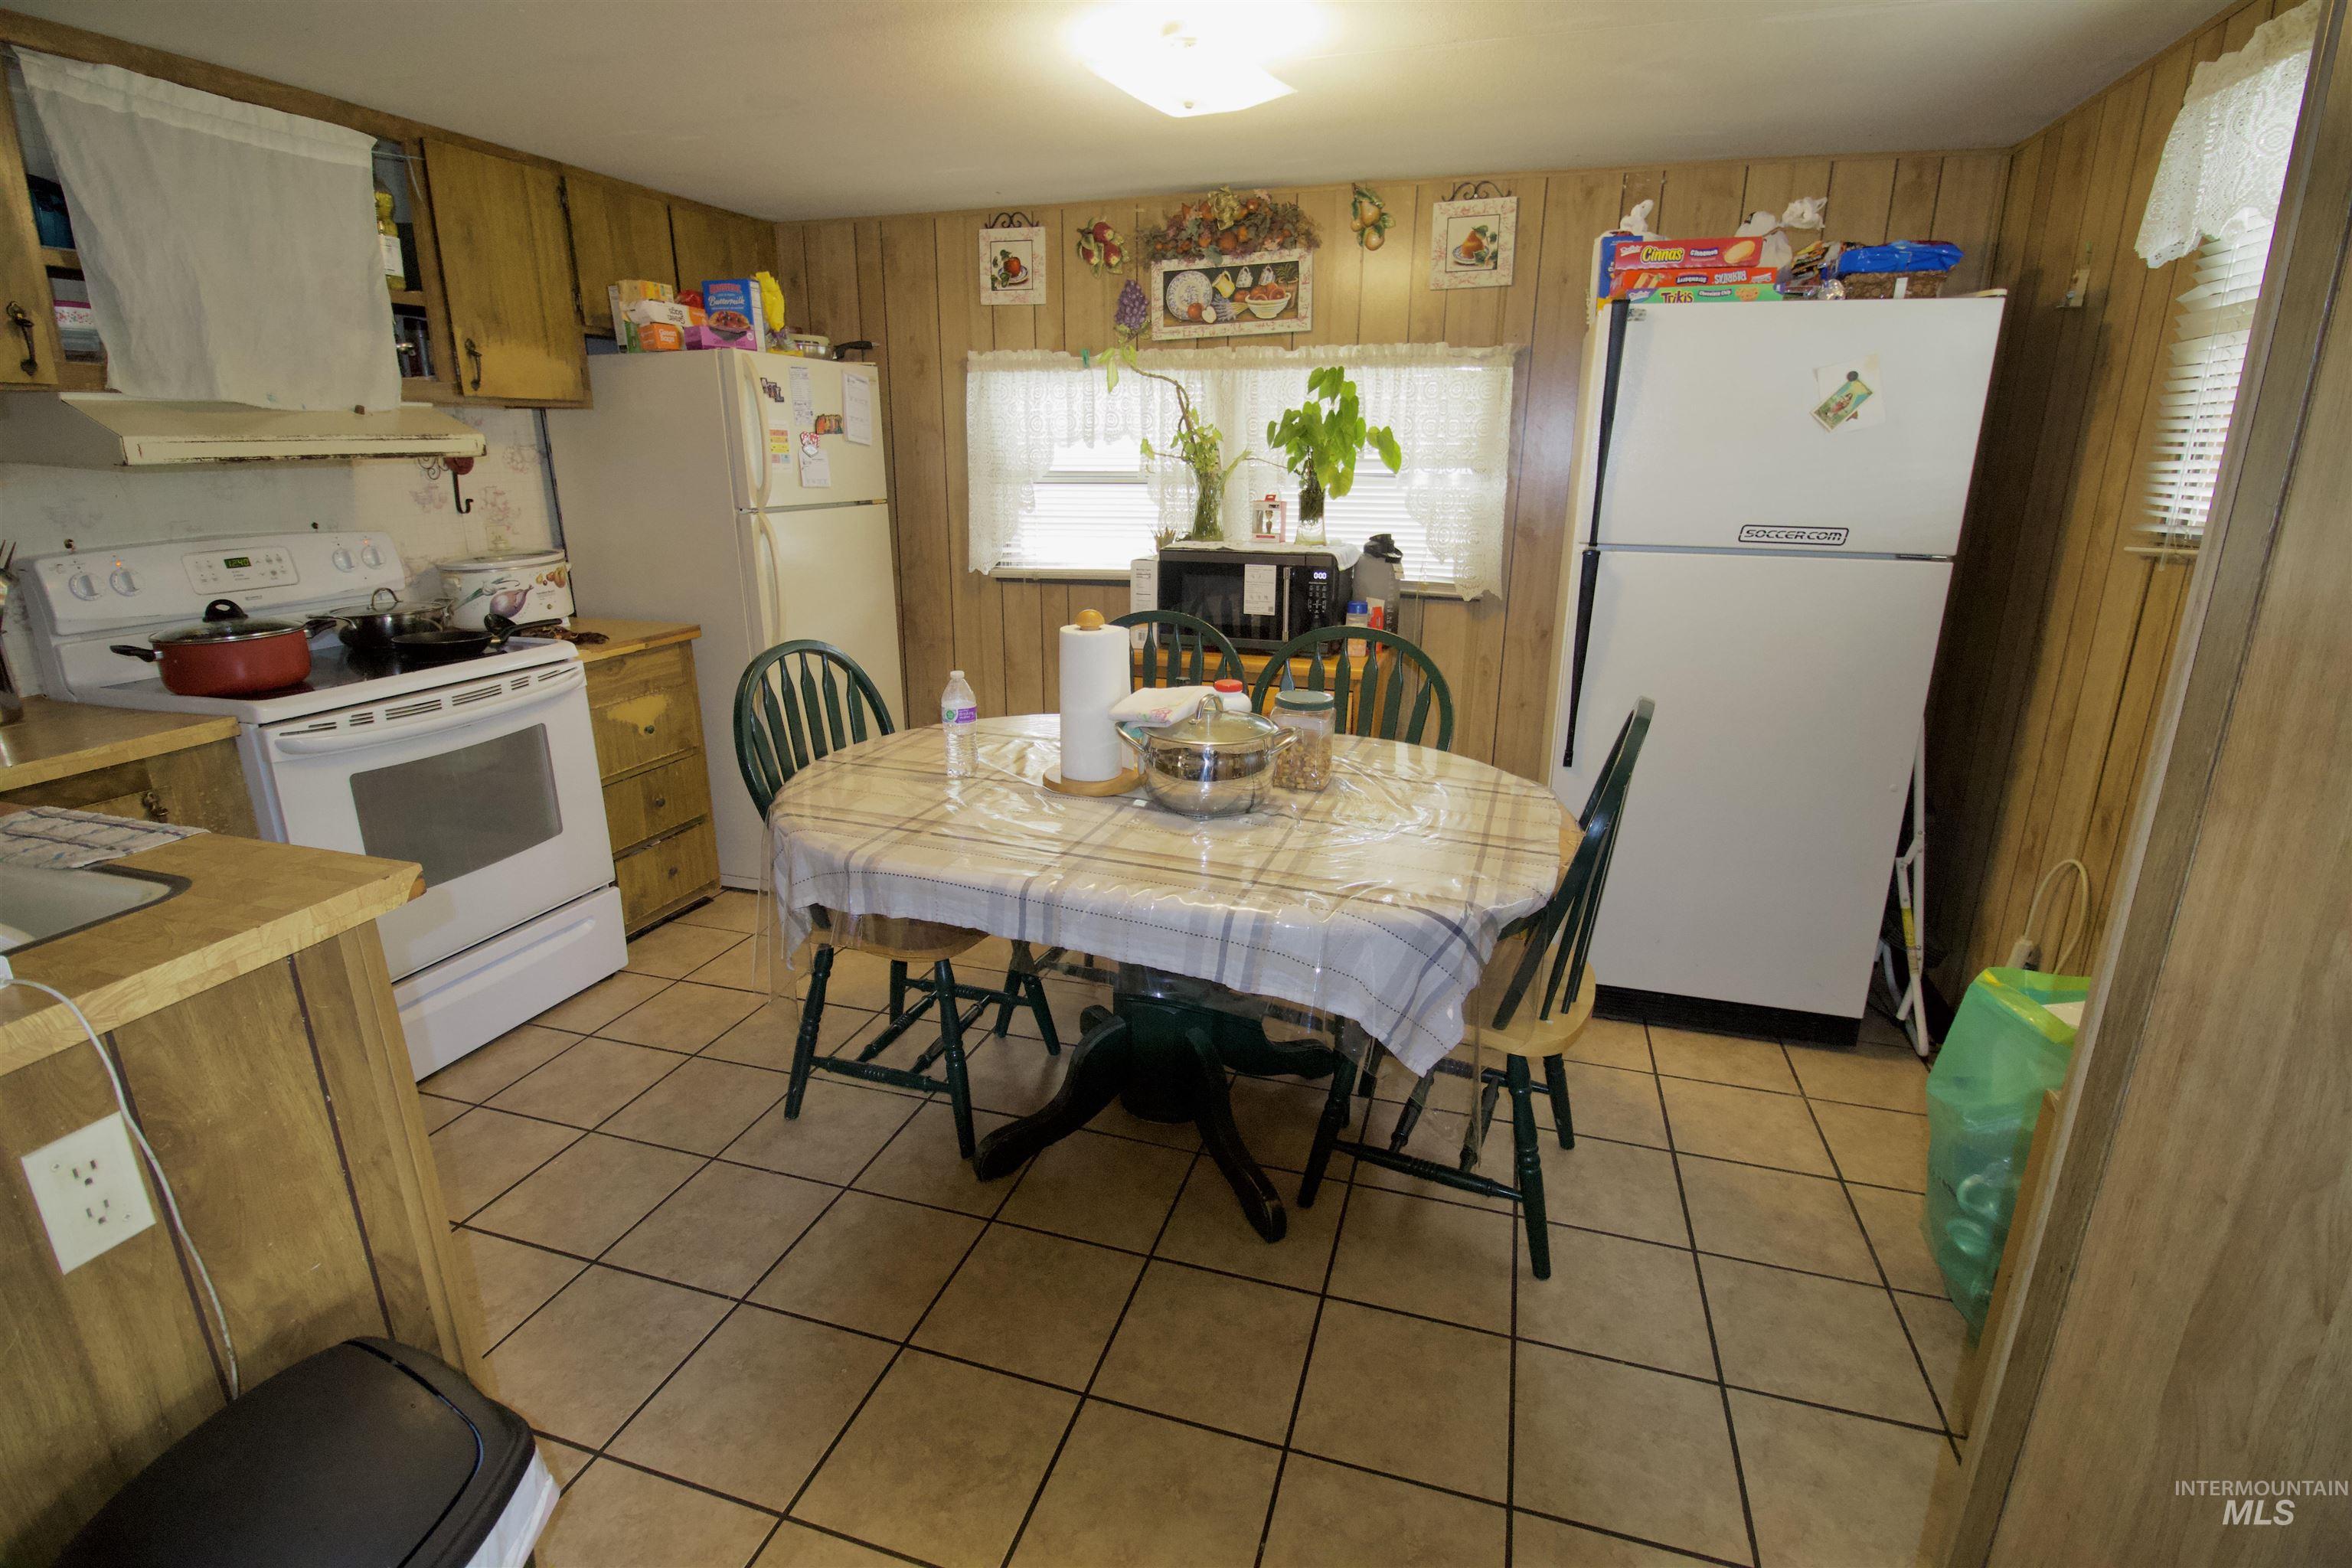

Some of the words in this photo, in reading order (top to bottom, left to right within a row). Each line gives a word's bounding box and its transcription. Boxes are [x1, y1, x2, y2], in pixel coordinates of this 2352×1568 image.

[1642, 245, 1684, 263] Cinnas
[708, 295, 745, 306] Buttermilk
[1661, 290, 1693, 304] Trikis
